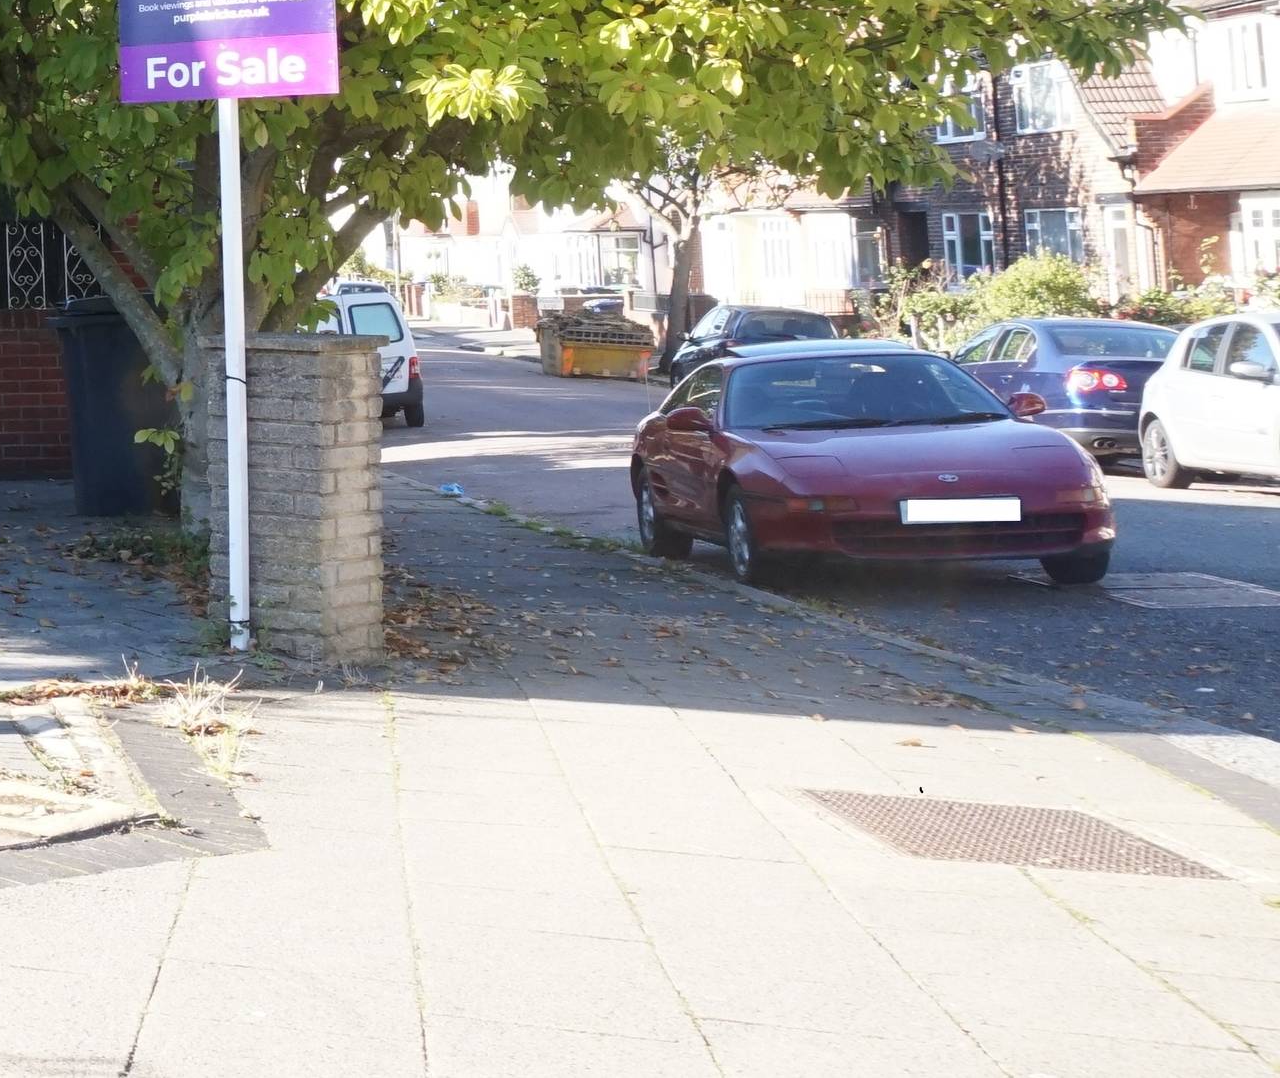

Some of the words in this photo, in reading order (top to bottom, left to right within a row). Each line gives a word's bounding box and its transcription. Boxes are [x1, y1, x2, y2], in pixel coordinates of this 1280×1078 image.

[138, 3, 159, 13] Book
[160, 1, 194, 11] viewings
[146, 56, 206, 90] For
[216, 47, 307, 87] Sale
